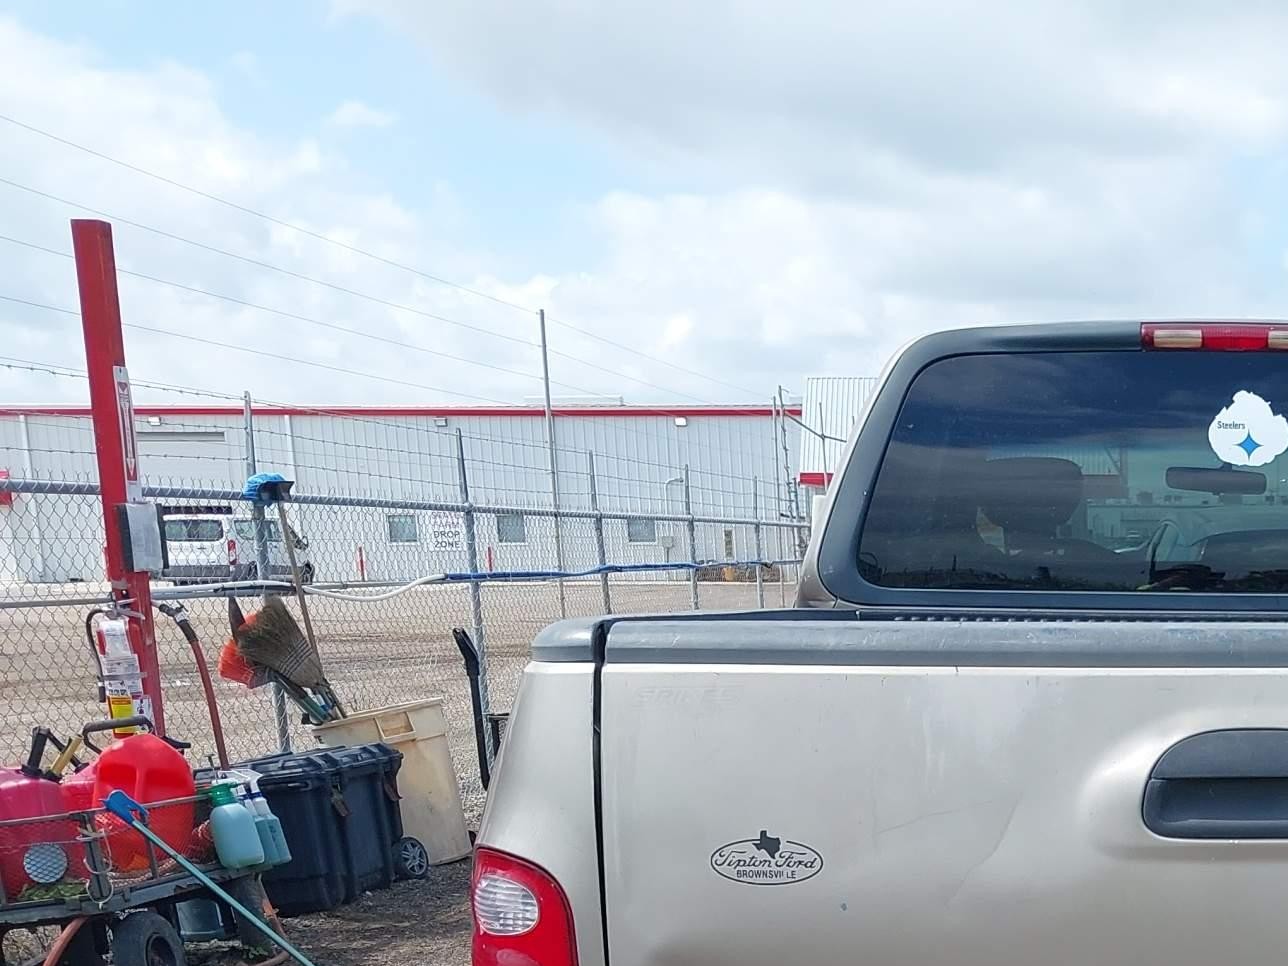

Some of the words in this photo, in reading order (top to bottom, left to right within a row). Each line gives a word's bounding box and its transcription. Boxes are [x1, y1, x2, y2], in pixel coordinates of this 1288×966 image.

[1217, 420, 1246, 430] Steelers
[433, 530, 460, 539] DROP
[434, 540, 461, 548] ZONE
[714, 849, 773, 869] Tipton
[775, 850, 818, 869] Ford
